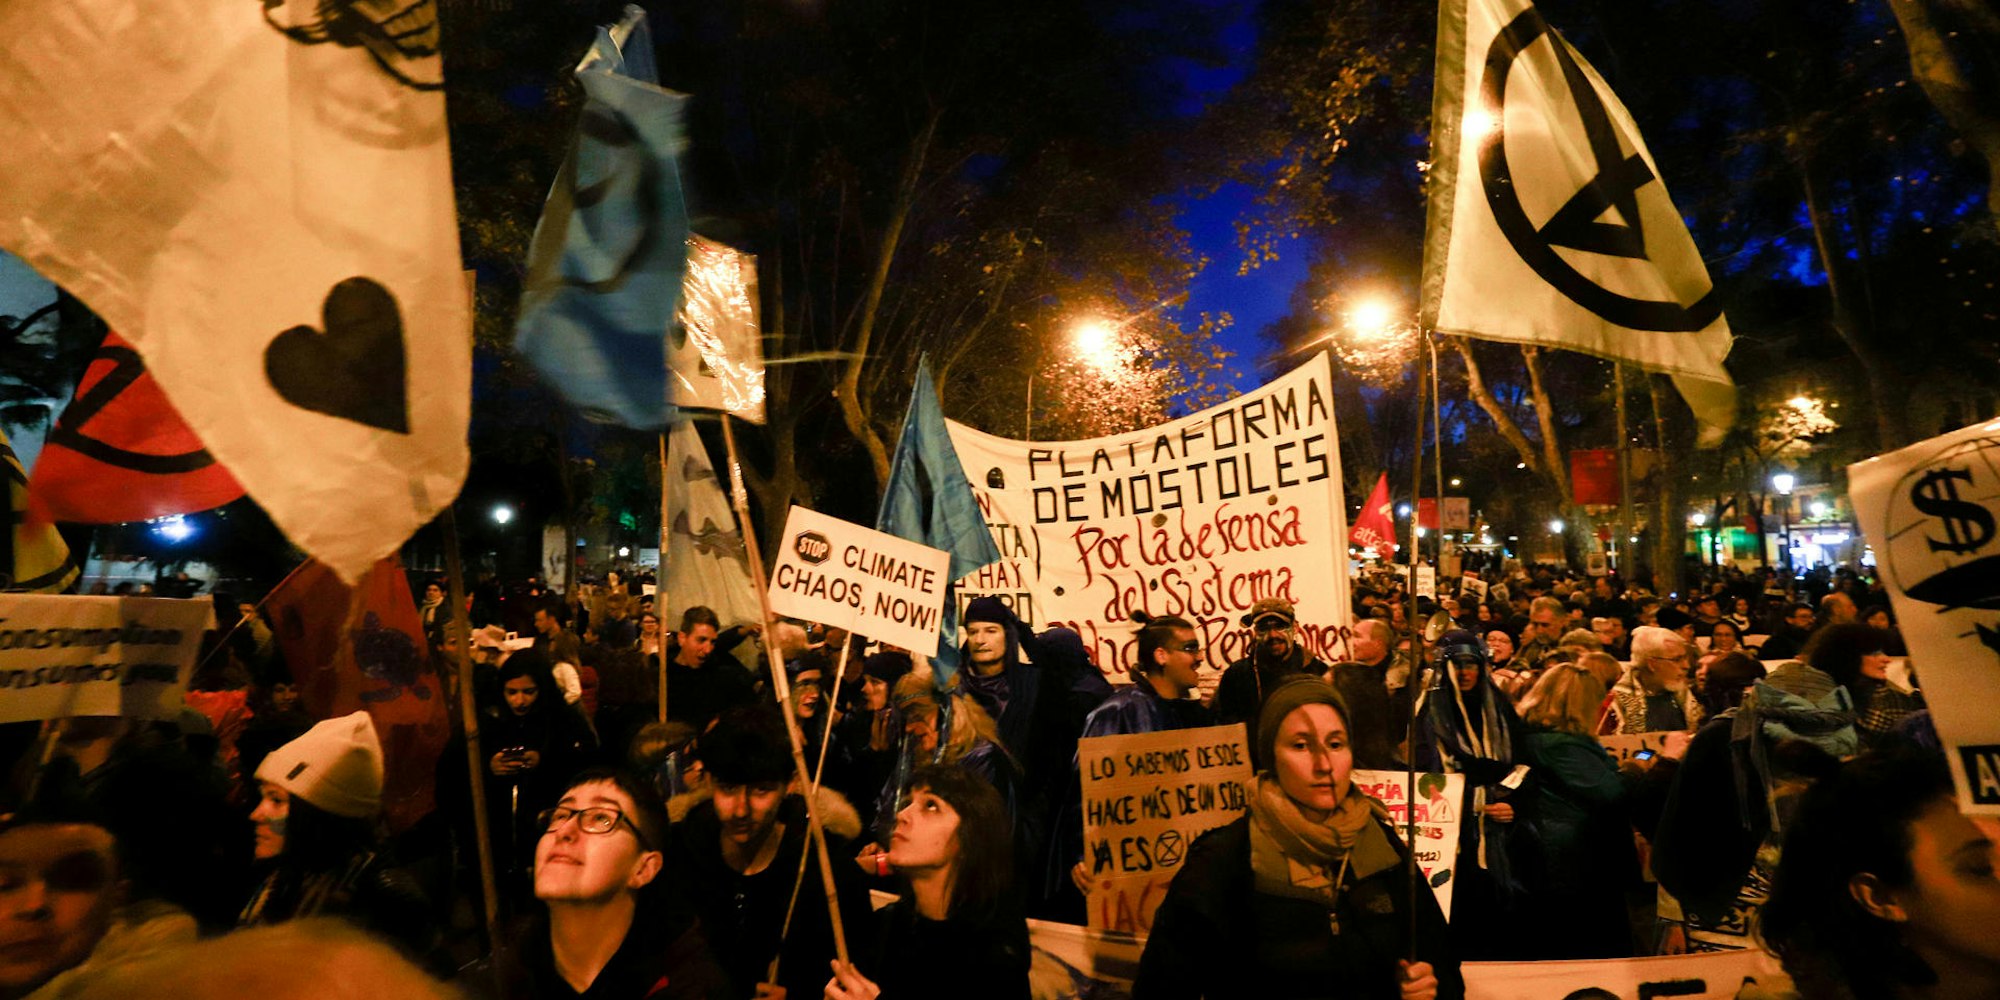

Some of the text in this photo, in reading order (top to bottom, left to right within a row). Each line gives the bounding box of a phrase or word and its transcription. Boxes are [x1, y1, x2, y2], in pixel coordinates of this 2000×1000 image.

[1028, 377, 1328, 481] PLATAFORMA
[1032, 433, 1330, 524] DE MÓSTOLES
[798, 536, 936, 595] STOP CLIMATE
[1070, 502, 1308, 590] Por la defensa
[1353, 526, 1394, 554] attac
[777, 563, 937, 633] CHAOS, NOW!
[979, 562, 1021, 589] HAY
[1099, 561, 1301, 623] del Sistema
[1090, 743, 1244, 781] LO SABEMOS DESDE
[1087, 795, 1138, 827] HACE
[1141, 785, 1171, 819] MÁS
[1176, 783, 1198, 816] DE
[1198, 783, 1215, 811] UN
[1091, 836, 1114, 876] YA
[1121, 836, 1153, 872] ES
